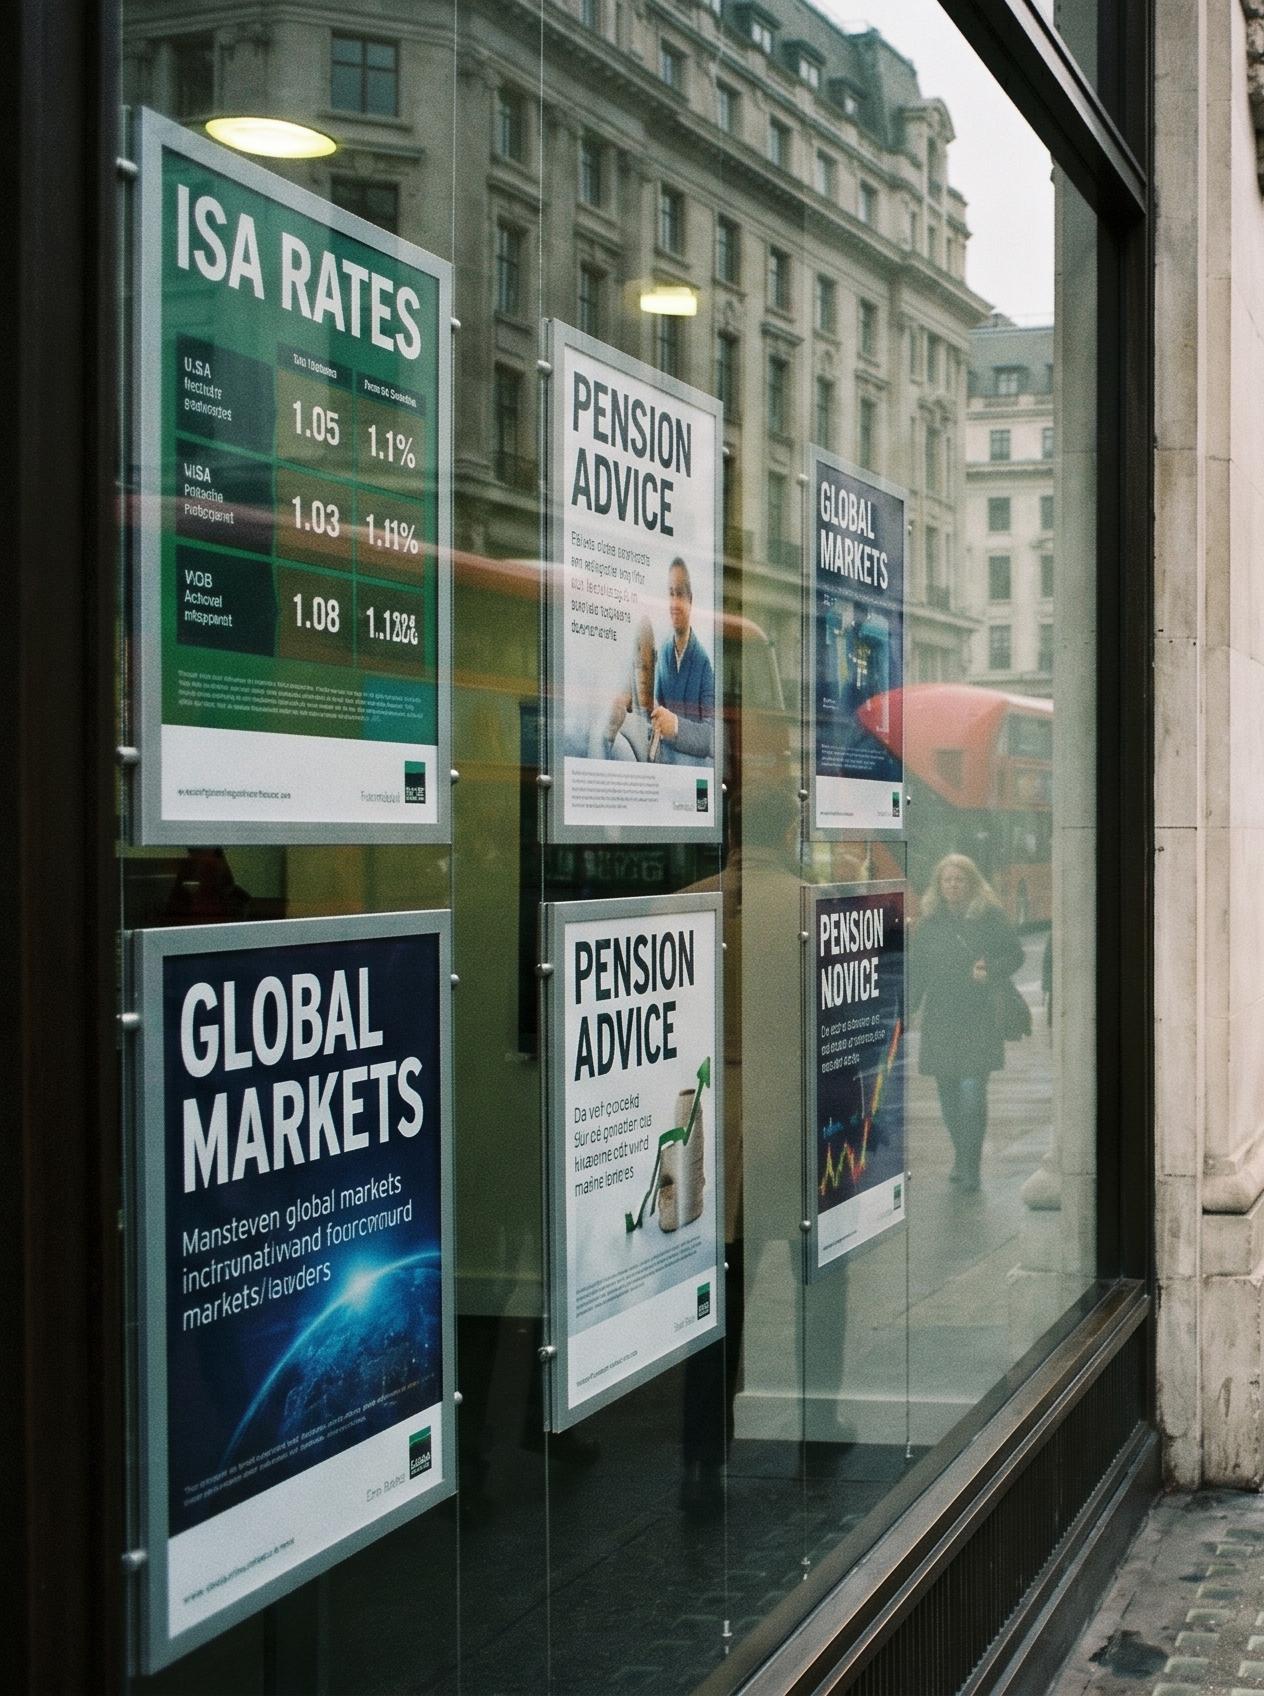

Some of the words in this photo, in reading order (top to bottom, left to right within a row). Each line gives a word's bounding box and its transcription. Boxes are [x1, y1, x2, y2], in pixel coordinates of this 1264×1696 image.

[177, 183, 265, 300] ISA
[281, 232, 421, 360] RATES
[293, 400, 340, 446] 1.05
[368, 424, 416, 469] 1.1%
[573, 370, 691, 478] PENSION
[292, 495, 340, 538] 1.03
[366, 513, 418, 555] 1.11%
[571, 447, 674, 537] ADVICE
[821, 481, 875, 540] GLOBAL
[820, 528, 889, 590] MARKETS
[293, 593, 340, 633] 1.08
[575, 930, 694, 1005] PENSION
[820, 908, 884, 957] PENSION
[821, 956, 880, 1010] NOVICE
[180, 967, 384, 1078] GLOBAL
[574, 1000, 678, 1082] ADVICE
[183, 1056, 425, 1194] MARKETS
[182, 1210, 280, 1257] Mansteven
[286, 1188, 335, 1232] global
[340, 1172, 402, 1210] markets
